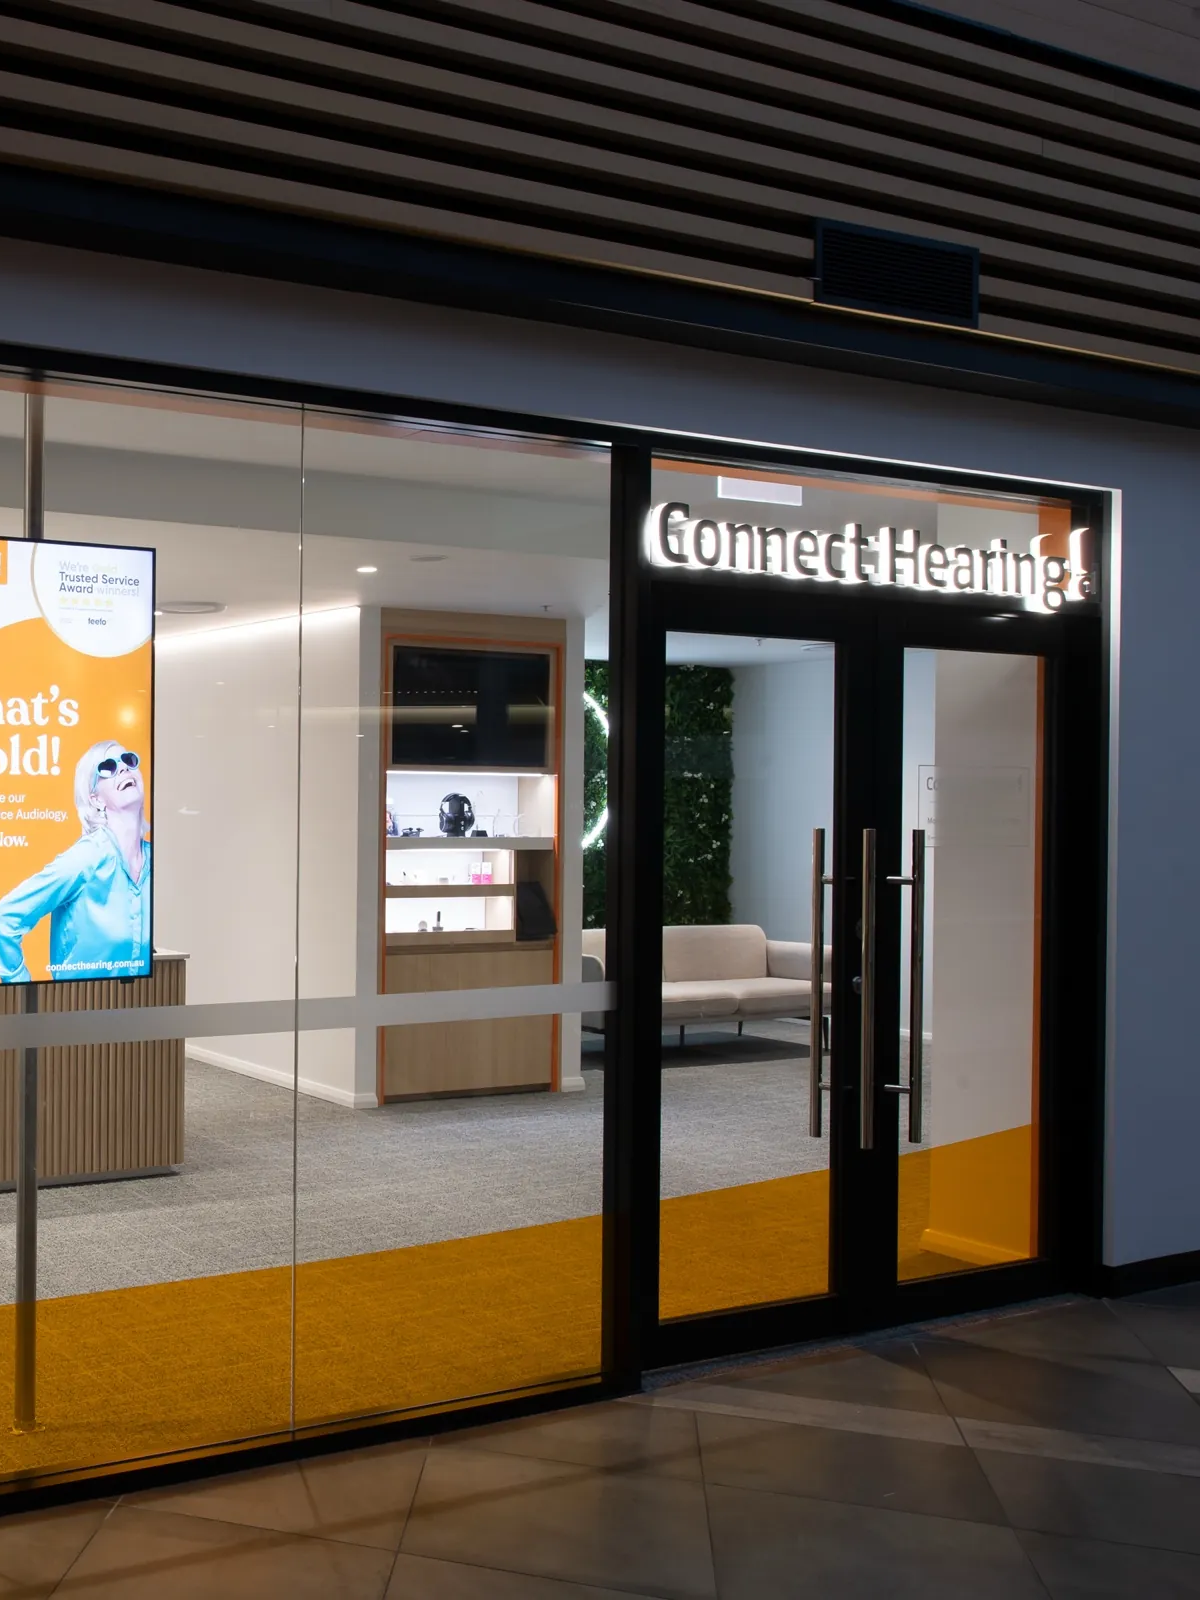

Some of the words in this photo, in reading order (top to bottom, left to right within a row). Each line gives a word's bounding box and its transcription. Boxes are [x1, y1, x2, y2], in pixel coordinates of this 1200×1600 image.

[652, 502, 869, 584] Connect
[59, 571, 99, 584] Trusted
[101, 574, 140, 587] Service
[59, 582, 94, 594] Award
[97, 585, 140, 597] winners!
[8, 794, 26, 804] our
[16, 808, 68, 823] Audiology.
[45, 959, 145, 972] connecthearing.com.au
